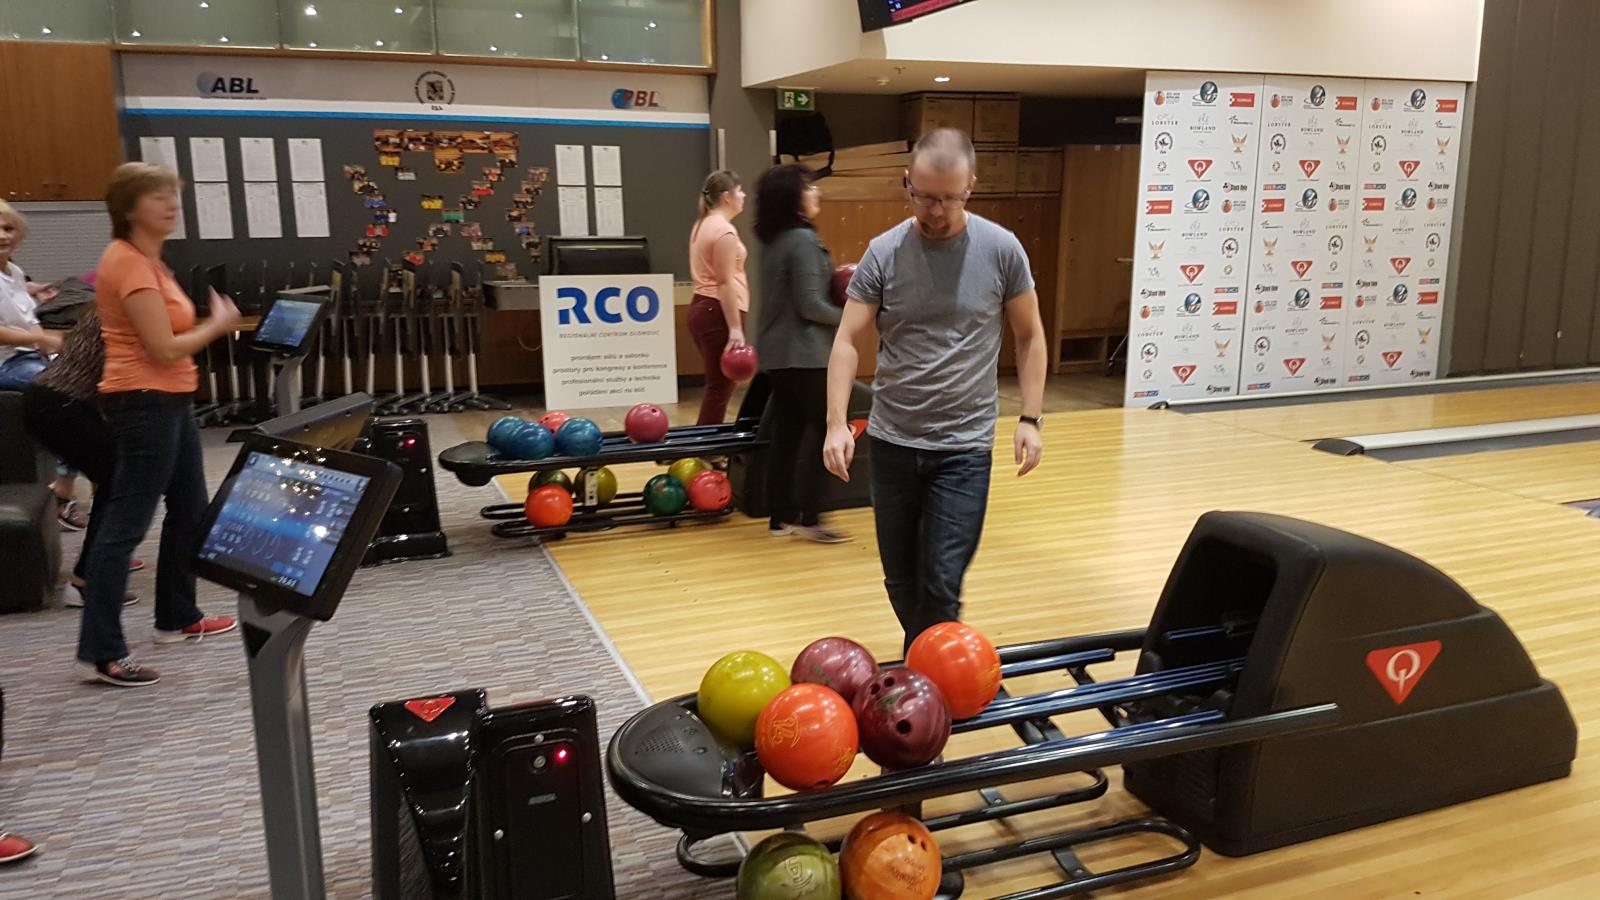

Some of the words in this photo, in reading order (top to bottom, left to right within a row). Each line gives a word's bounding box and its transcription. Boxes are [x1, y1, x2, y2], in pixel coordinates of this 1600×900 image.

[211, 77, 259, 94] ABL
[556, 286, 660, 325] RCO
[1386, 649, 1421, 694] Q
